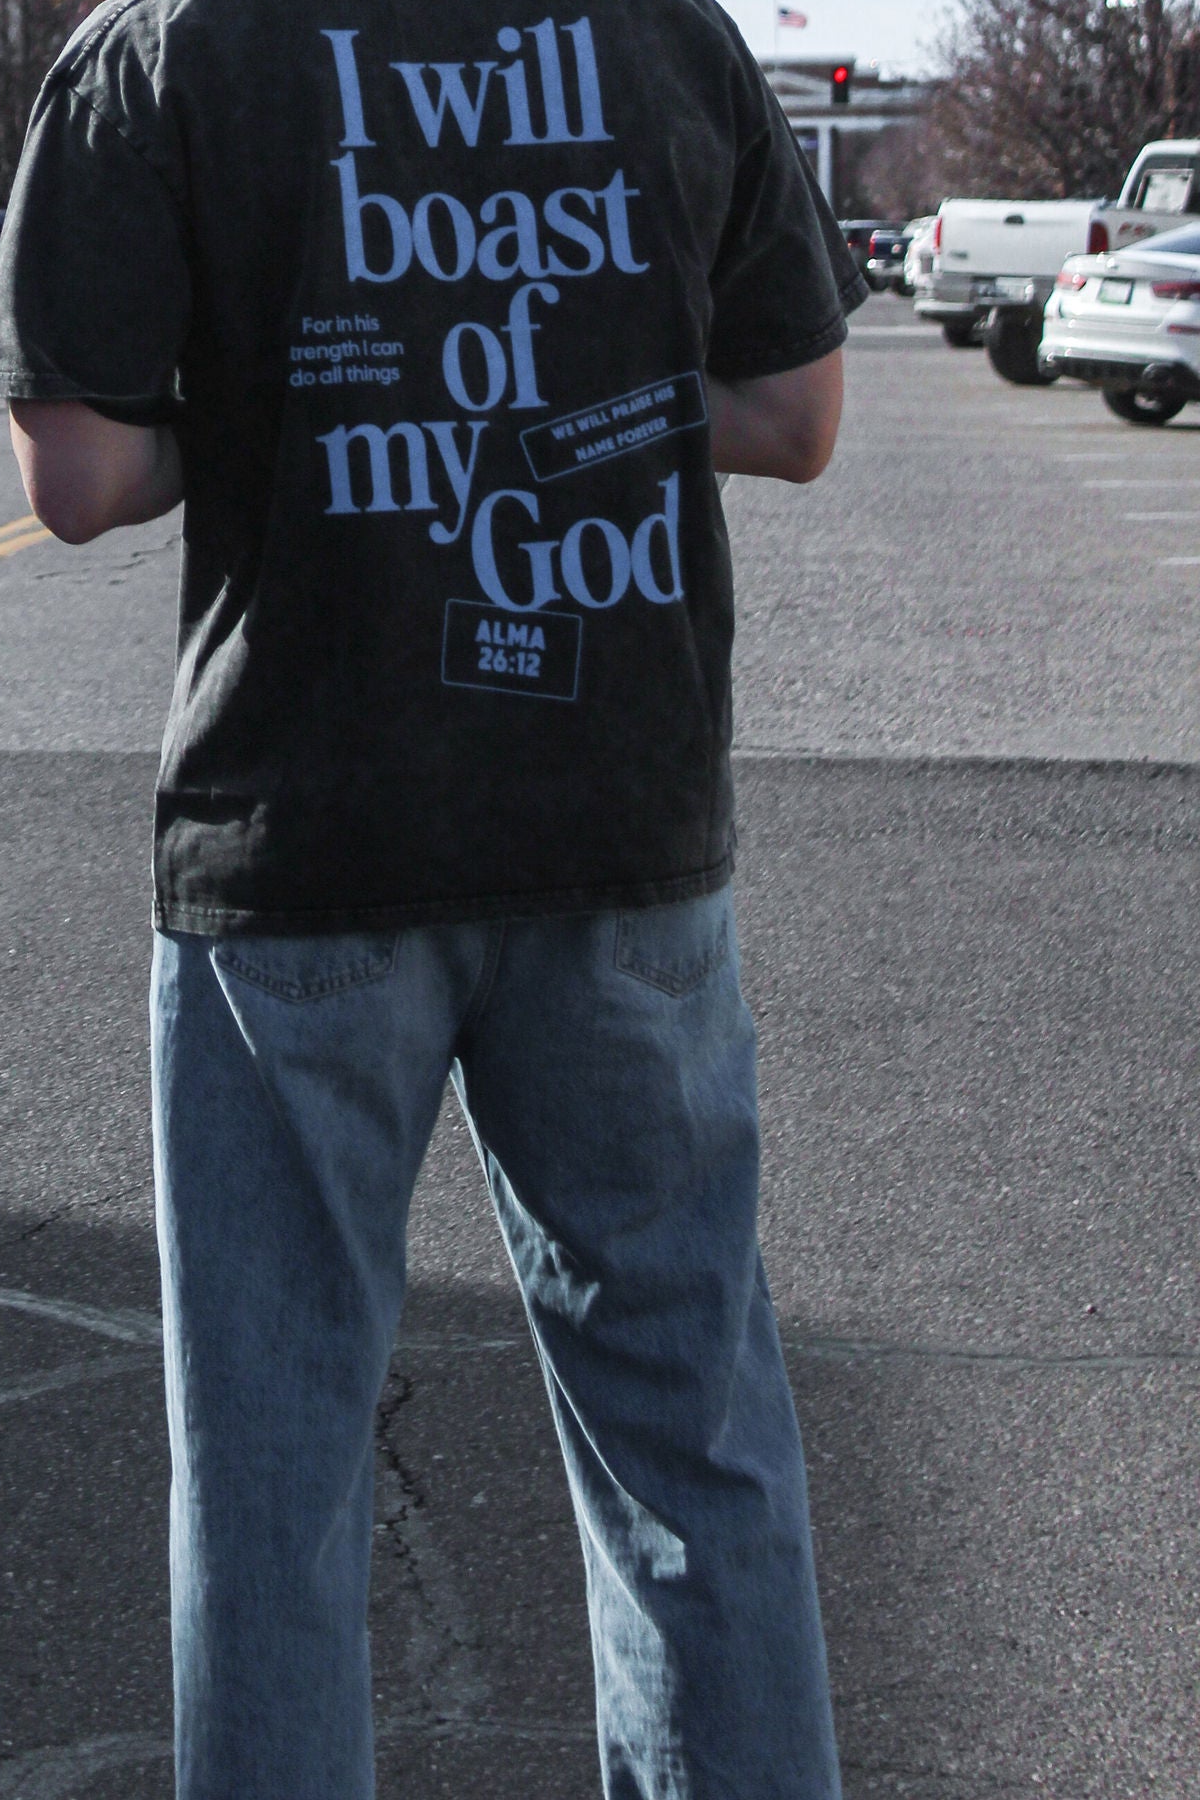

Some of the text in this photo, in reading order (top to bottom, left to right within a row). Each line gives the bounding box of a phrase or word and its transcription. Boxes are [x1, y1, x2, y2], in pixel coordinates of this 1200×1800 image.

[319, 16, 615, 149] I will
[329, 150, 650, 283] boast
[302, 313, 380, 334] For in his
[441, 281, 560, 413] of
[289, 340, 360, 362] trength
[370, 341, 404, 356] can
[289, 363, 400, 388] do all things
[551, 385, 676, 440] WE WILL PRAISE HIS
[575, 416, 669, 462] NAME FOREVER
[316, 419, 489, 546] my
[471, 471, 685, 613] God
[475, 619, 546, 650] ALMA
[478, 646, 541, 678] 26:12
